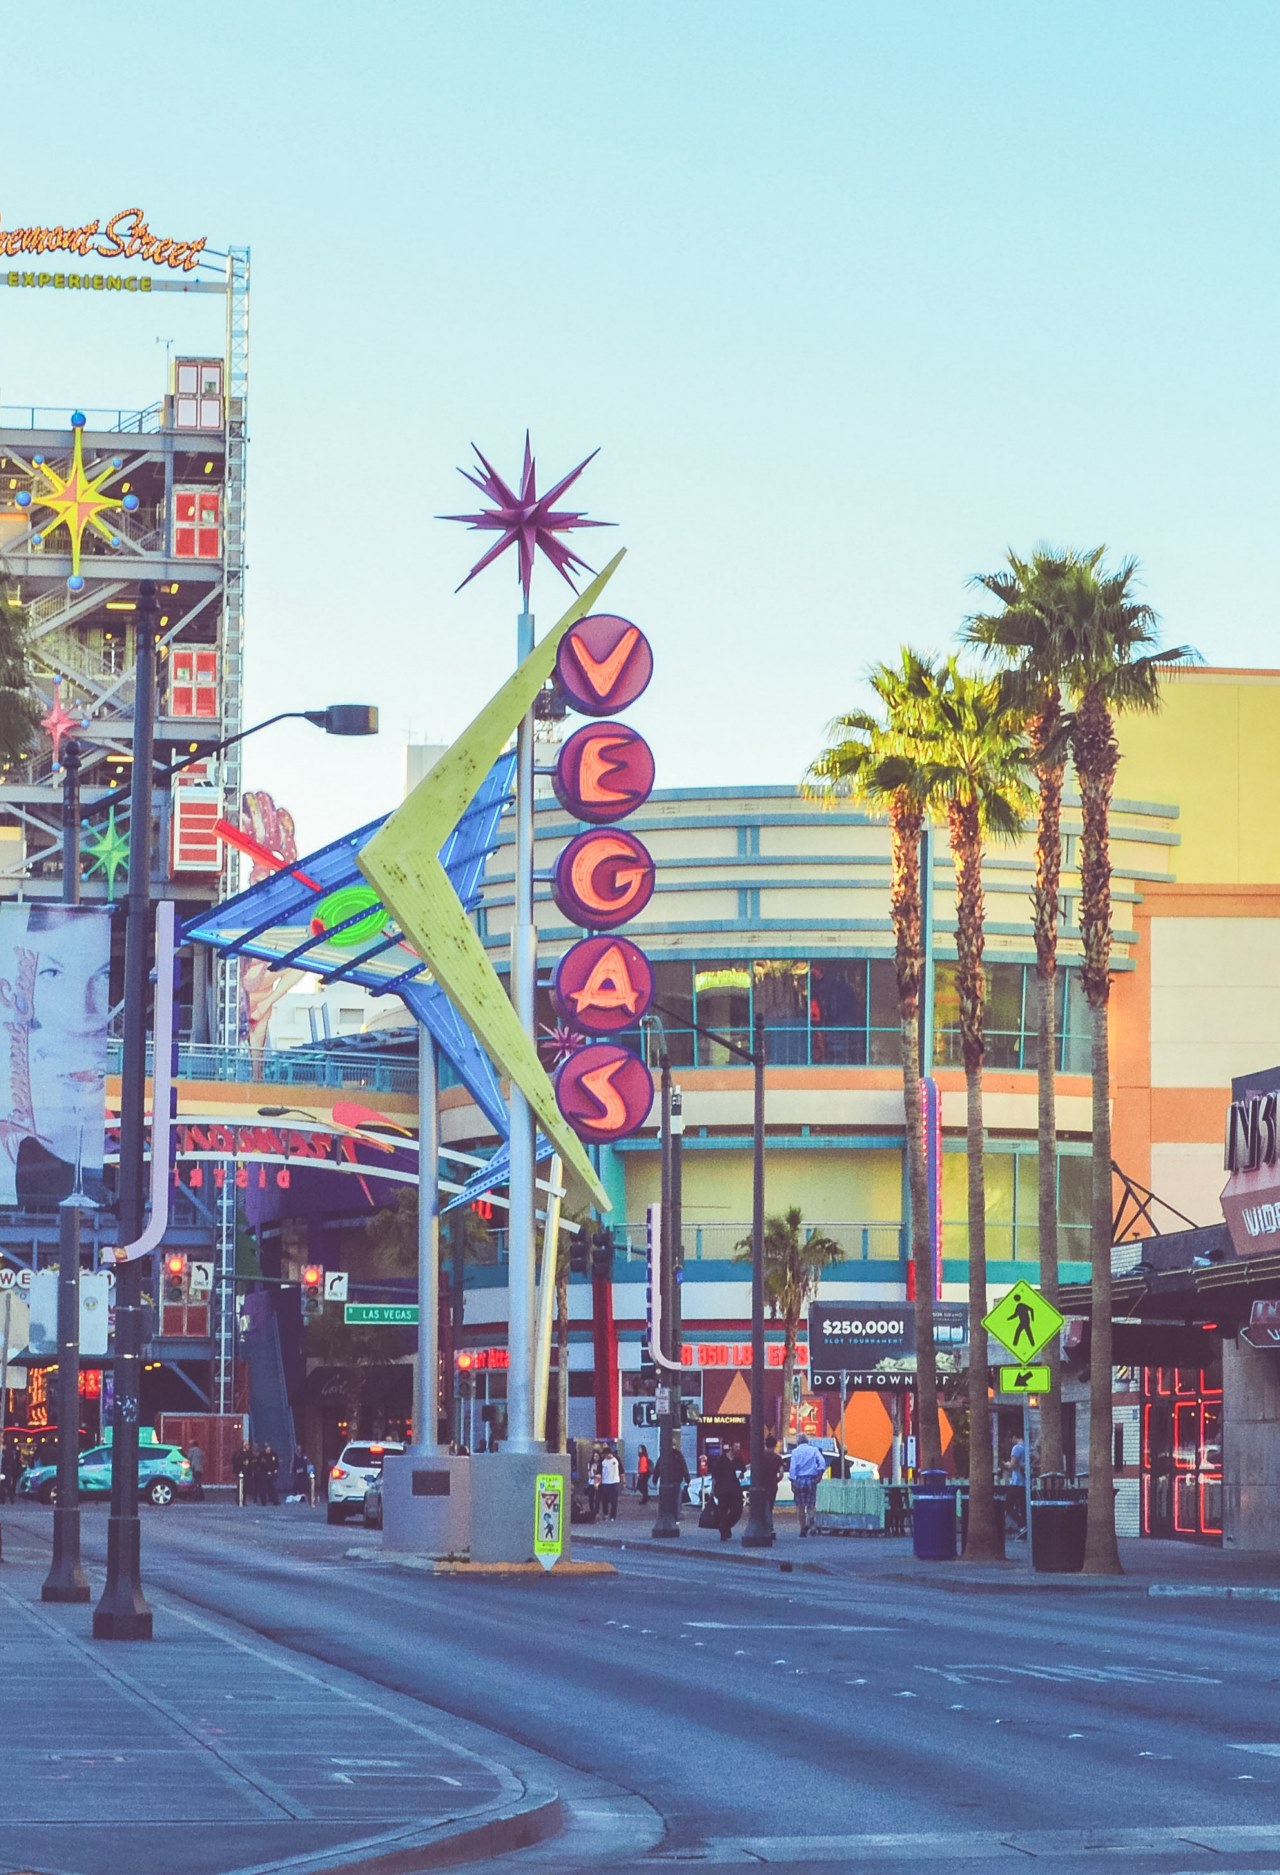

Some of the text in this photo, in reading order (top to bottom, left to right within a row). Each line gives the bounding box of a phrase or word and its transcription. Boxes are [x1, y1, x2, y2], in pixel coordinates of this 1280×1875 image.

[97, 207, 208, 272] Street
[6, 271, 152, 292] EXPERIENCE
[568, 626, 652, 1131] VEGAS
[362, 1310, 380, 1320] LAS
[382, 1310, 413, 1320] VEGAS
[822, 1319, 904, 1336] $250,000!
[697, 1344, 729, 1366] 350
[732, 1344, 754, 1366] LB
[697, 1416, 746, 1425] ATM MACHINE
